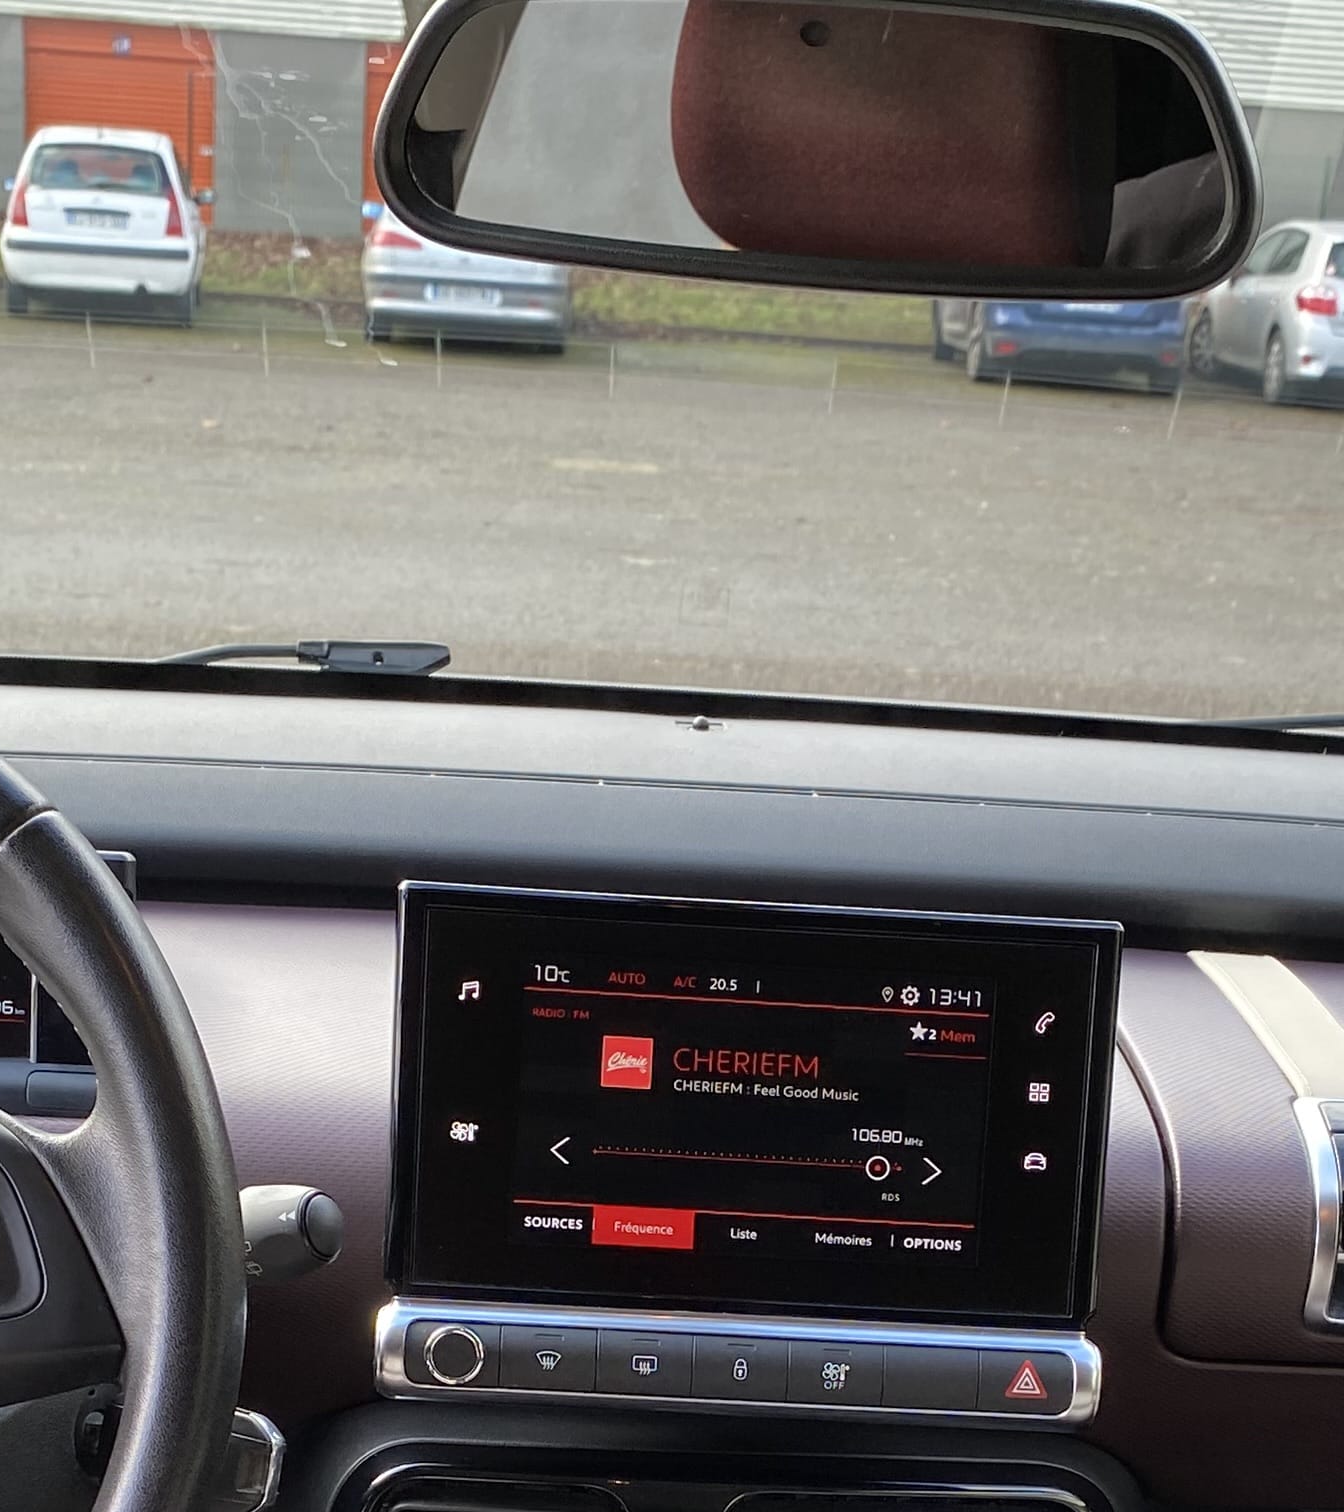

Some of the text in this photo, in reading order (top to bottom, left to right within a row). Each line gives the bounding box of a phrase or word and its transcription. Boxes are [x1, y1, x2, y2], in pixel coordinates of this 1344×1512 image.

[608, 972, 646, 985] AUTO
[673, 975, 697, 989] A/C
[709, 977, 738, 992] 20.5
[928, 987, 982, 1008] 13:41
[927, 1028, 976, 1043] 2 Mem
[673, 1047, 819, 1080] CHERIEFM
[673, 1078, 743, 1095] CHERIEFM
[753, 1084, 780, 1097] Feel
[783, 1085, 818, 1099] Good
[821, 1087, 859, 1102] Music
[904, 1136, 924, 1147] MHz
[881, 1192, 900, 1202] RDS
[523, 1215, 962, 1252] SOURCES Fréquence Liste Mémoires OPTIONS
[823, 1380, 846, 1391] OFF
